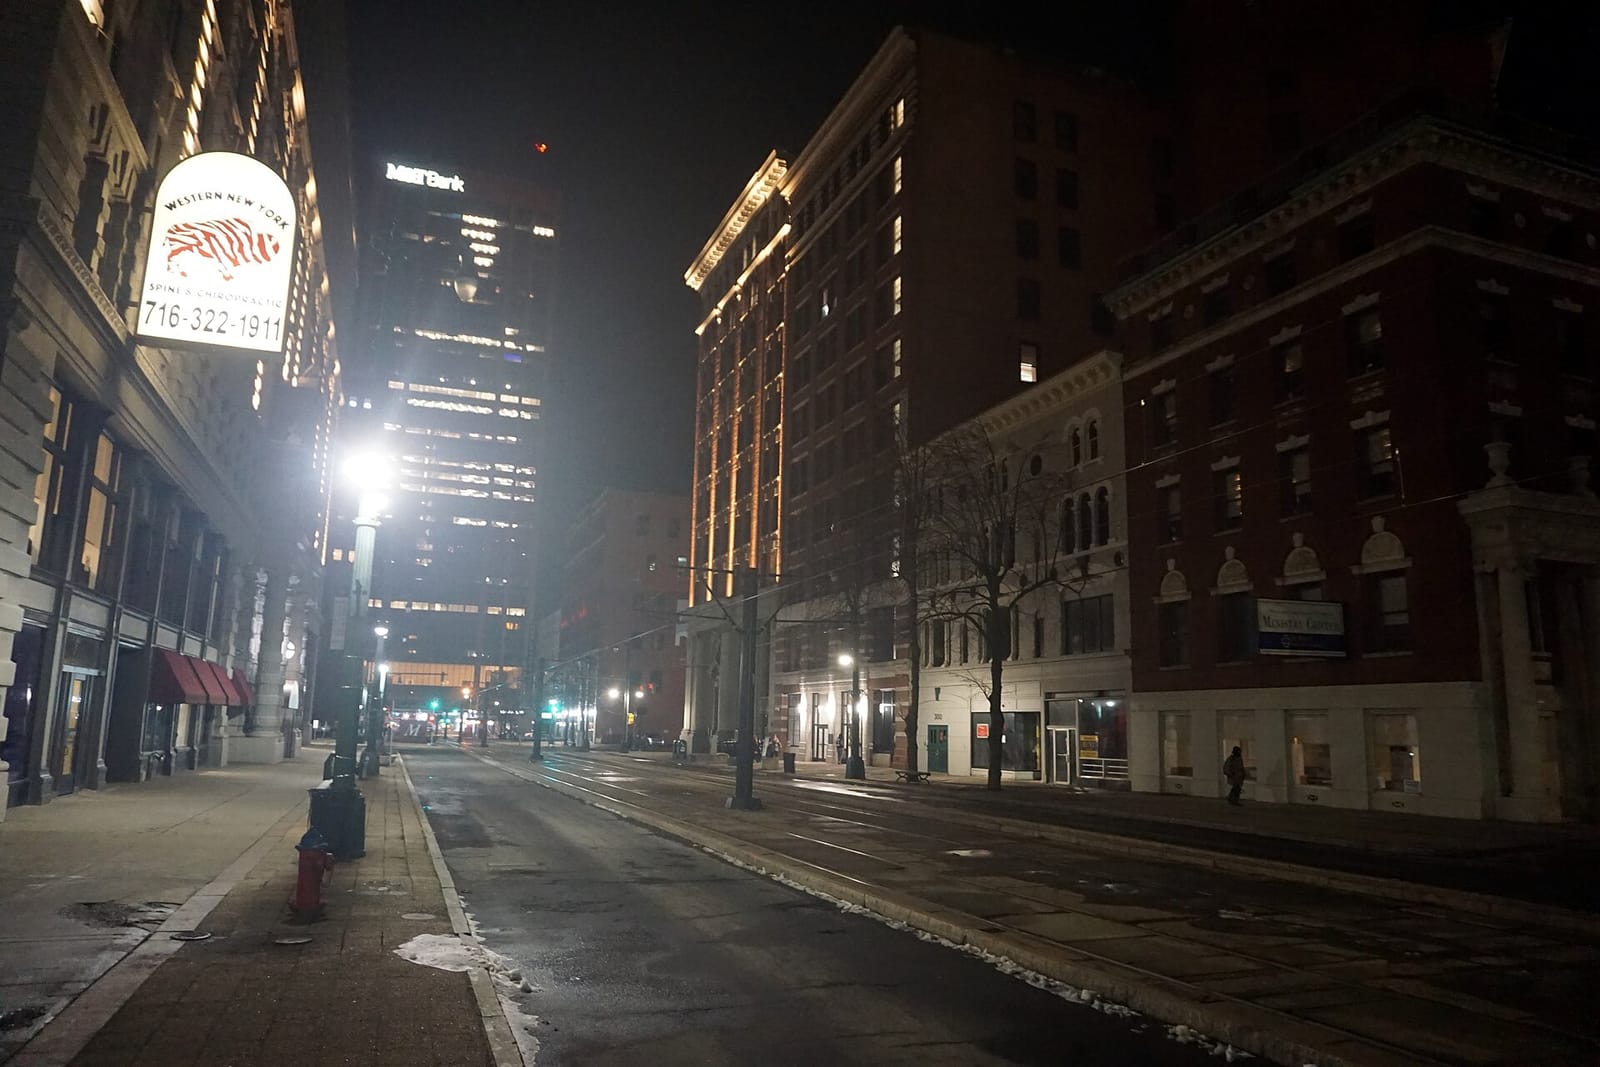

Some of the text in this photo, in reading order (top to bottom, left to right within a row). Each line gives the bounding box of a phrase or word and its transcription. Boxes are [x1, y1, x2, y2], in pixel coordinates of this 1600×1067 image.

[164, 191, 290, 231] WESTERN NEW YORK
[145, 300, 282, 341] 716-322-1911
